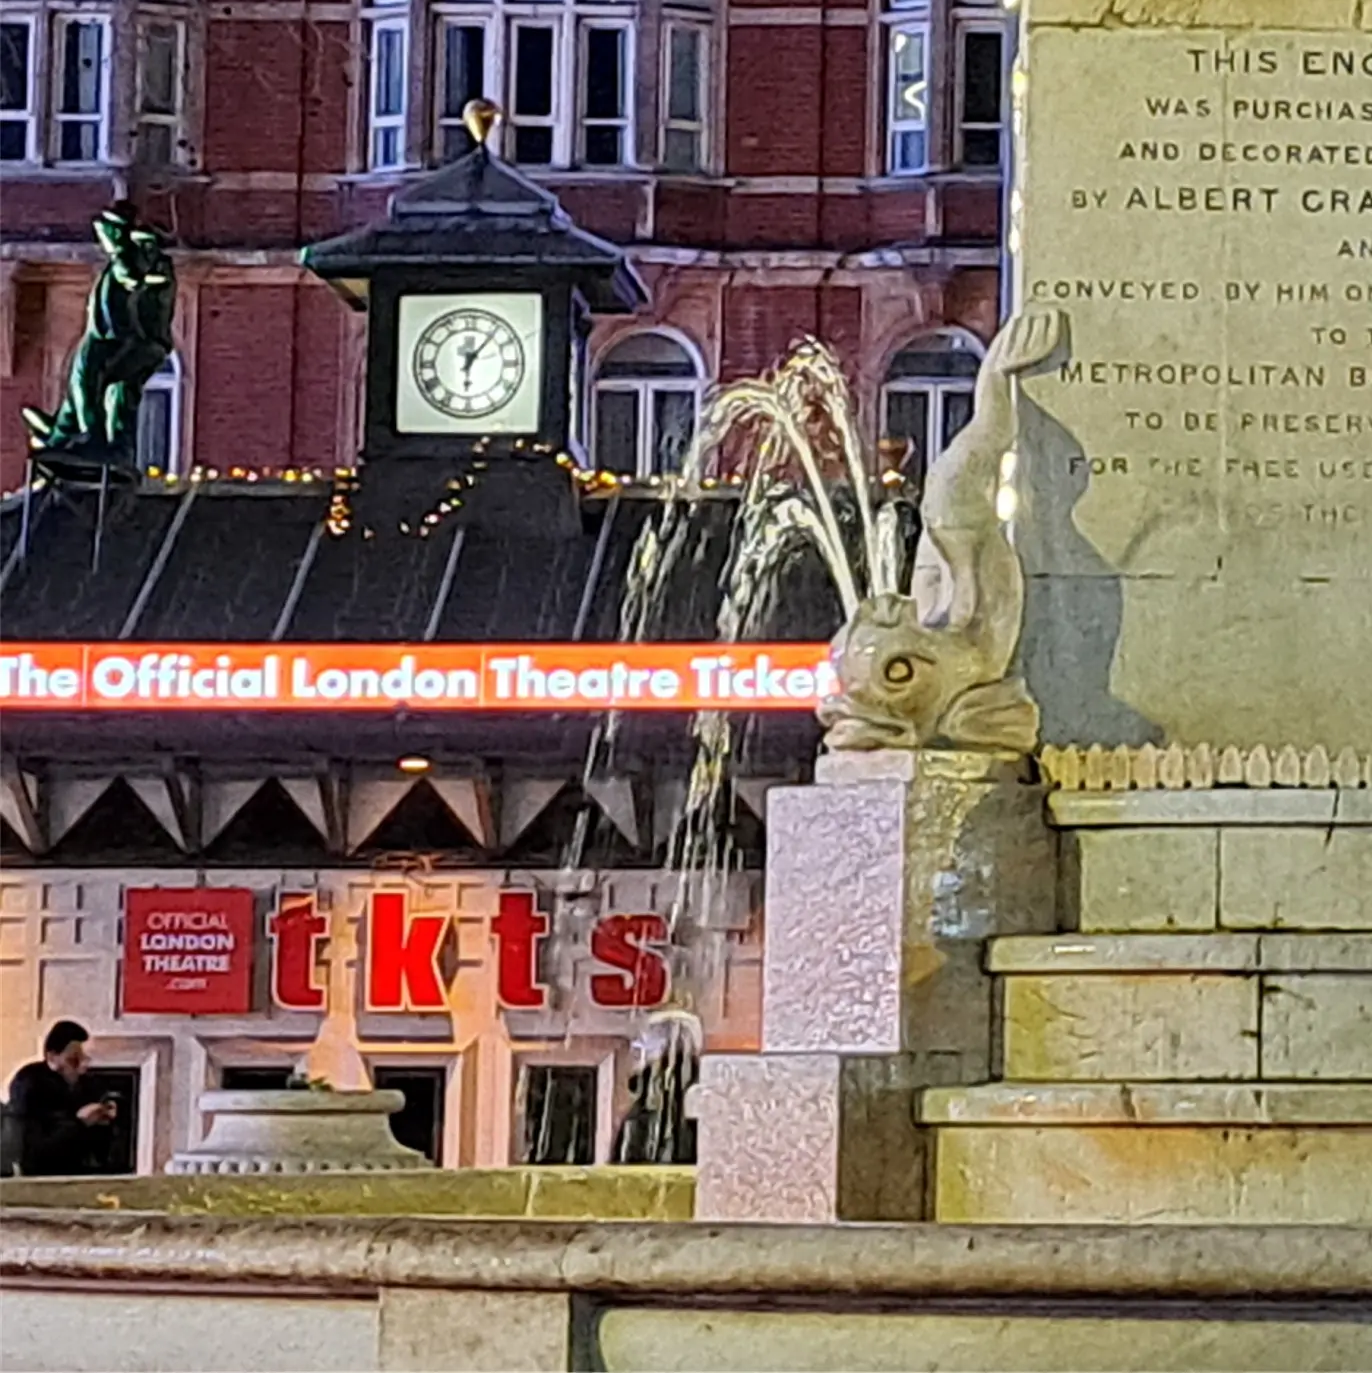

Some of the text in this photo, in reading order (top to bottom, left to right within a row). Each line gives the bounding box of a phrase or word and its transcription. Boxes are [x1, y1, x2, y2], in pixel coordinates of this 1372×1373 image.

[1188, 49, 1278, 74] THIS
[1146, 97, 1210, 118] WAS
[1118, 142, 1180, 162] AND
[1072, 190, 1108, 210] BY
[1125, 188, 1280, 214] ALBERT
[1032, 280, 1199, 301] CONVEYED
[1225, 281, 1260, 301] BY
[1276, 283, 1329, 303] HIM
[1311, 327, 1347, 345] TO
[1060, 361, 1325, 387] METROPOLITAN
[1125, 412, 1162, 431] TO
[1069, 456, 1128, 475] FOR
[1225, 458, 1298, 479] FREE
[0, 653, 78, 698] The
[92, 654, 277, 699] Official
[293, 658, 477, 699] London
[489, 657, 679, 700] Theatre
[147, 912, 228, 930] OFFICIAL
[140, 933, 234, 950] LONDON
[267, 891, 672, 1011] tkts
[143, 954, 230, 972] THEATRE
